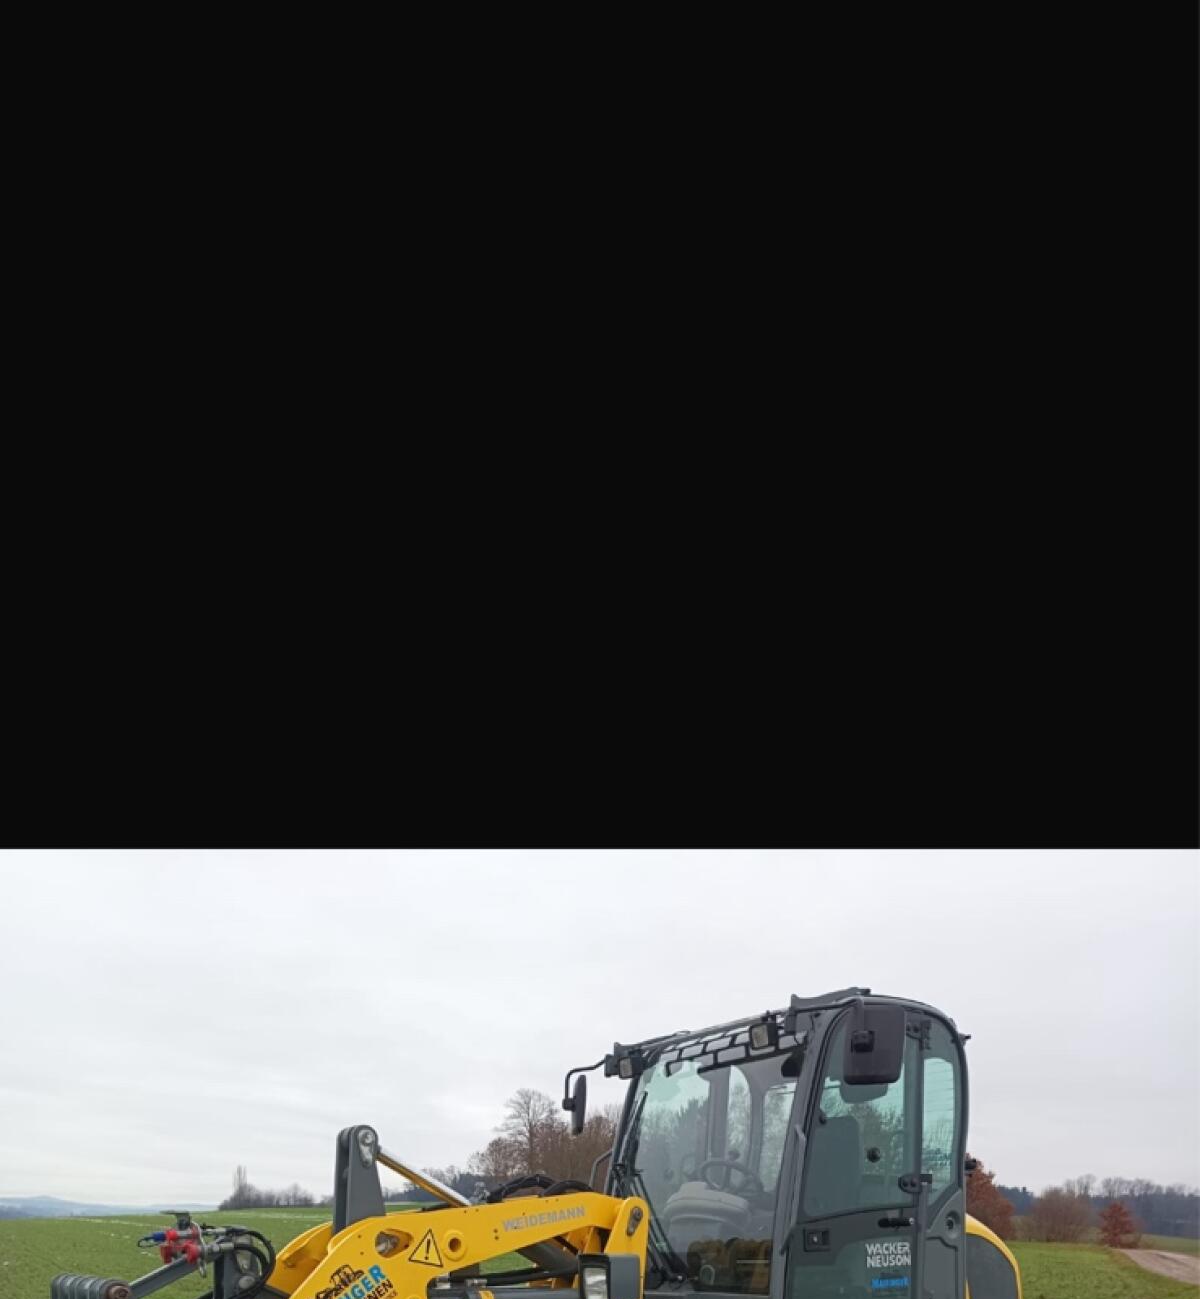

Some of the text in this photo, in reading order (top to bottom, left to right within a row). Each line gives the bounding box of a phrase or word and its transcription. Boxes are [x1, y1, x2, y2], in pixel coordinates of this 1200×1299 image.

[503, 1205, 585, 1232] WEIDEMANN
[865, 1242, 910, 1255] WACKER
[866, 1254, 911, 1268] NEUSON
